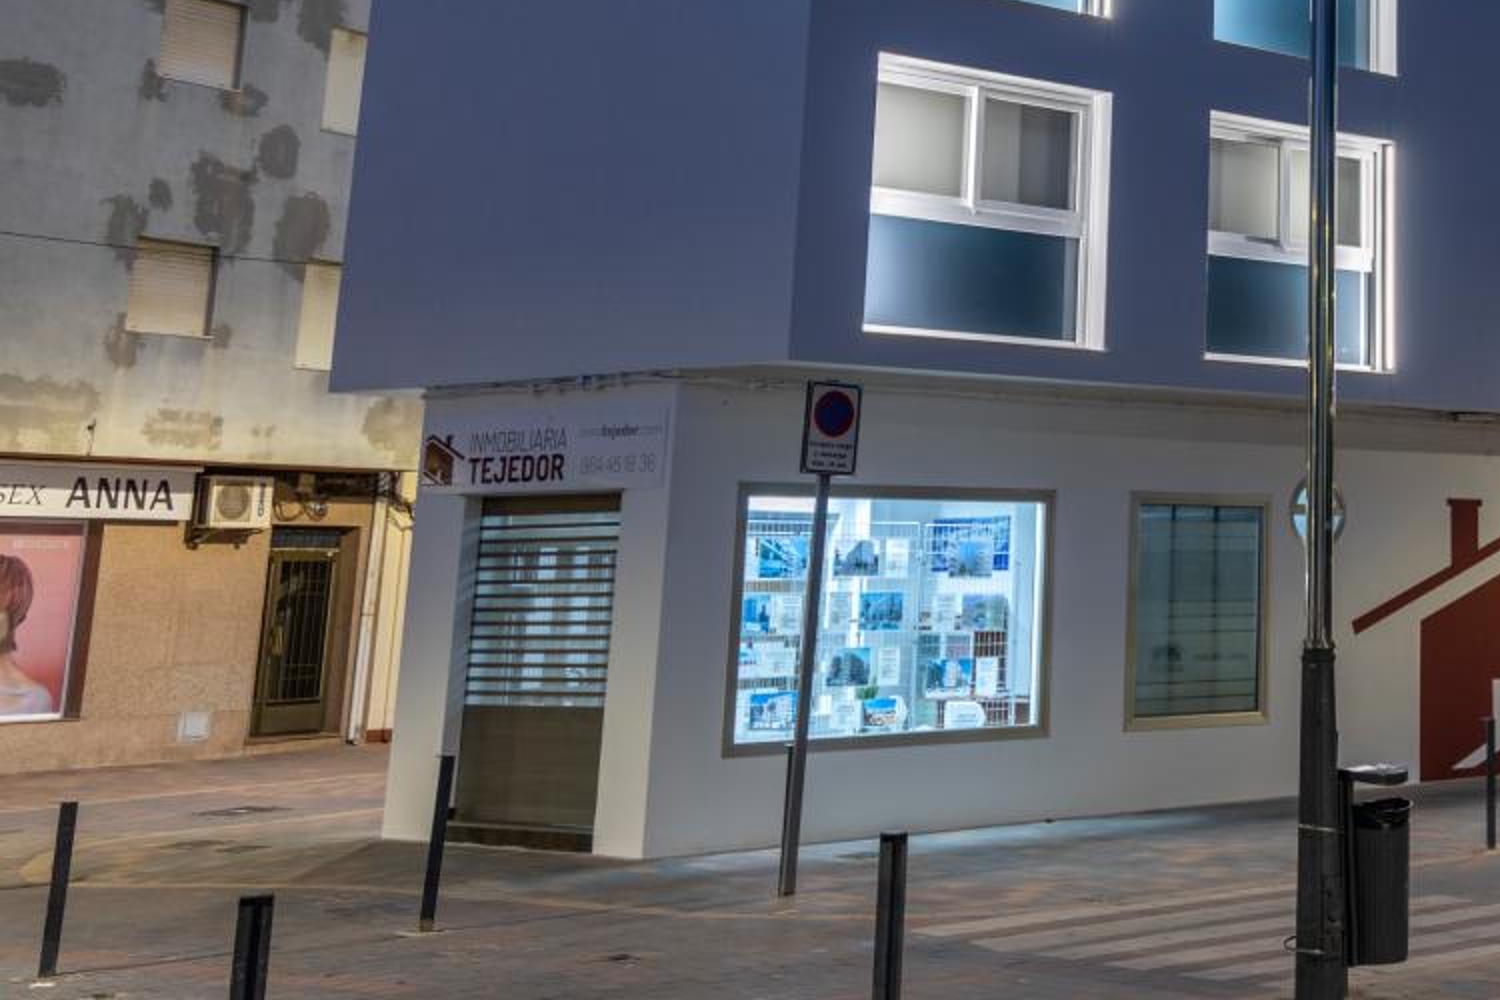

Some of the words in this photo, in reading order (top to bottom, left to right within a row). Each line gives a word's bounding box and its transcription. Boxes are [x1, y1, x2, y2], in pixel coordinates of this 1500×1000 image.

[470, 427, 568, 452] INMOBILIARIA
[469, 454, 565, 485] TEJEDOR
[65, 477, 174, 511] ANNA
